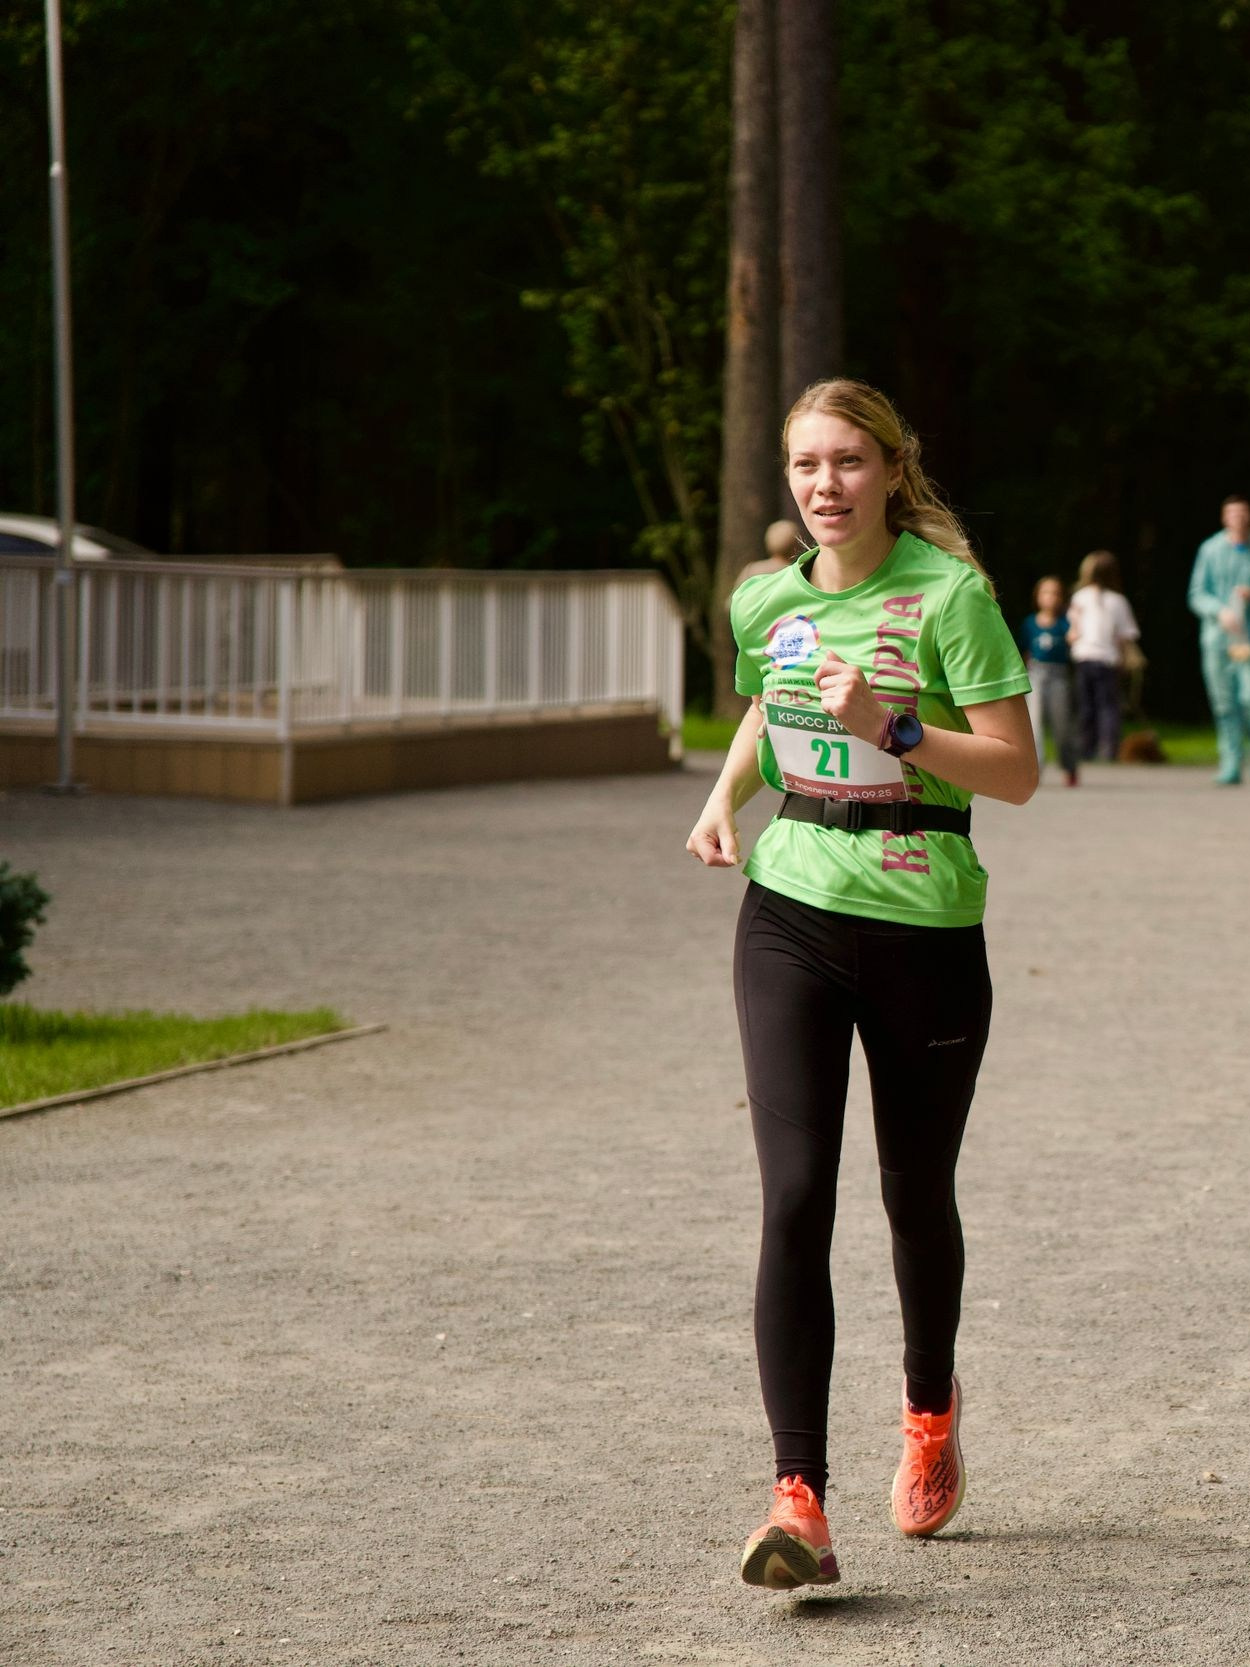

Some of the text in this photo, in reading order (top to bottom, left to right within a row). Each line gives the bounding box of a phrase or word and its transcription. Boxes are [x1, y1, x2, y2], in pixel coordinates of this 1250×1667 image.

[777, 711, 824, 729] КРОСС
[810, 738, 849, 779] 27
[847, 788, 893, 799] 14.09.25
